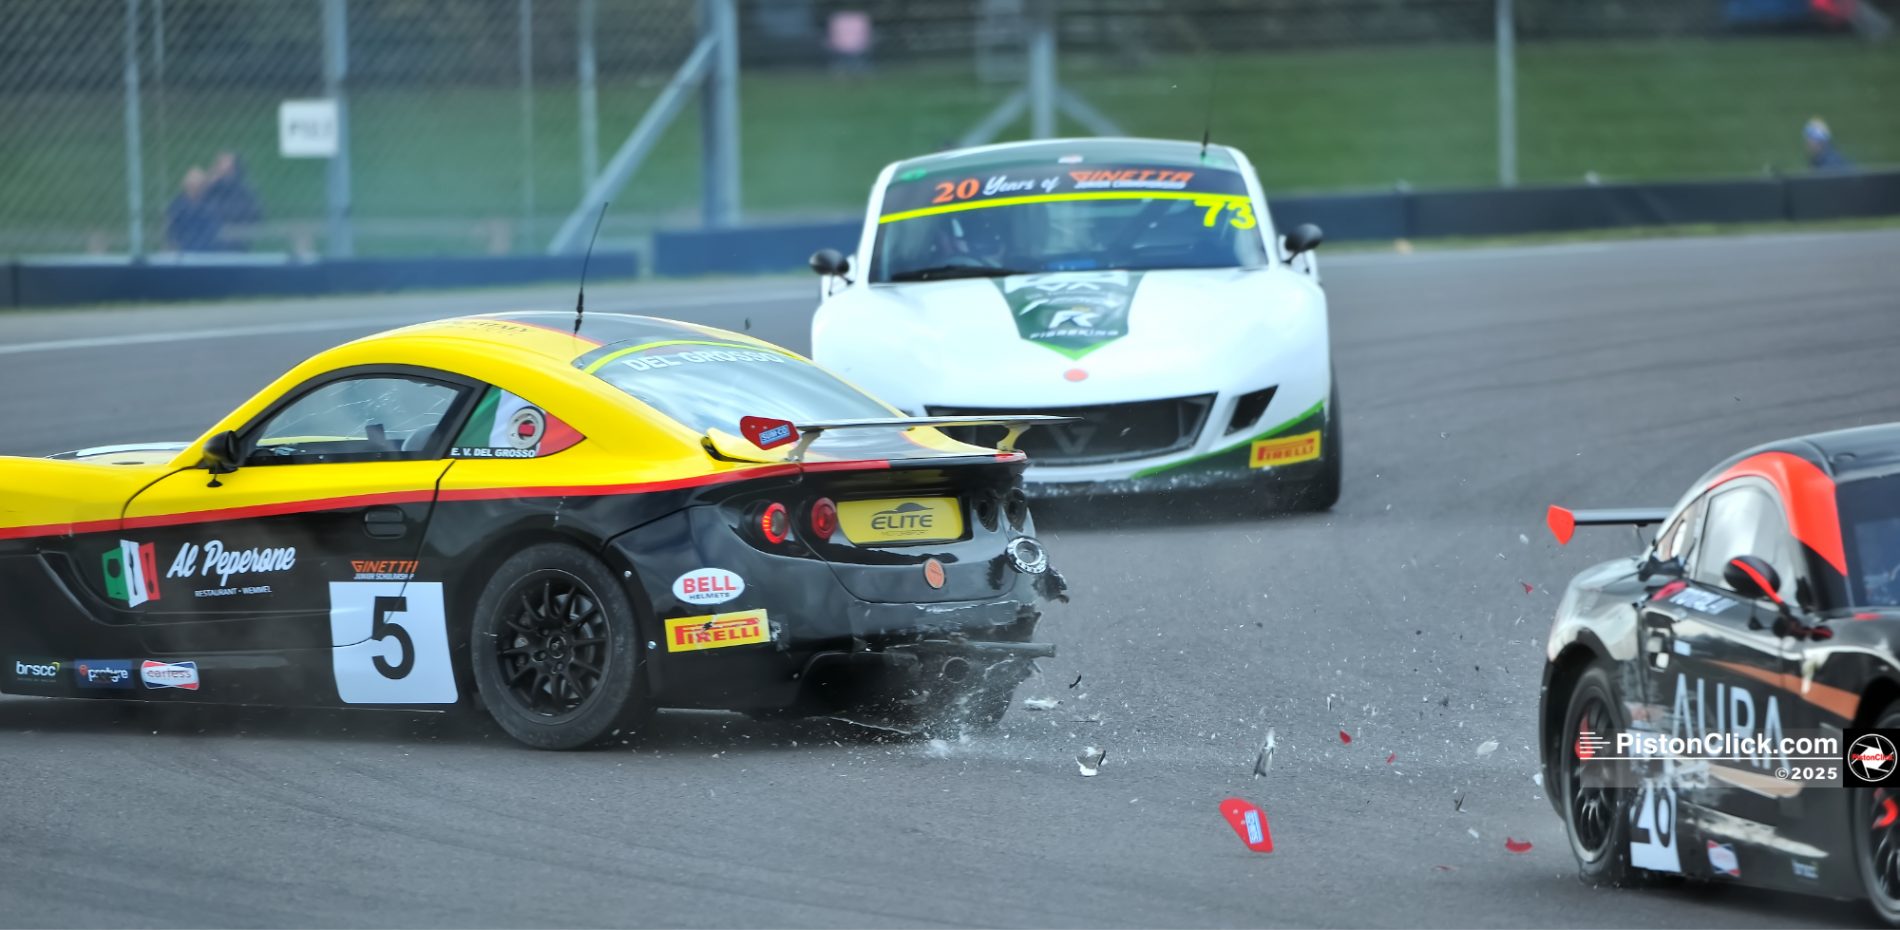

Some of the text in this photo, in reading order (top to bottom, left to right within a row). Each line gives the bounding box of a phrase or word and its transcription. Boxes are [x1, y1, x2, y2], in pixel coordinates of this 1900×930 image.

[933, 179, 980, 204] 20
[982, 176, 1034, 195] Years
[1041, 177, 1059, 193] of
[1194, 199, 1256, 229] 73
[621, 351, 785, 372] DEL GROSSO
[451, 448, 536, 458] E. V. DEL GROSSO
[1257, 438, 1315, 462] PIRELLI
[871, 514, 933, 530] ELITE
[166, 540, 296, 587] Al Peperone
[351, 560, 419, 573] GINETTA
[683, 575, 737, 594] BELL
[689, 592, 731, 600] HELMETS
[371, 596, 416, 680] 5
[674, 617, 760, 646] PIRELLI
[16, 660, 57, 677] brscc
[1671, 673, 1794, 773] AURA
